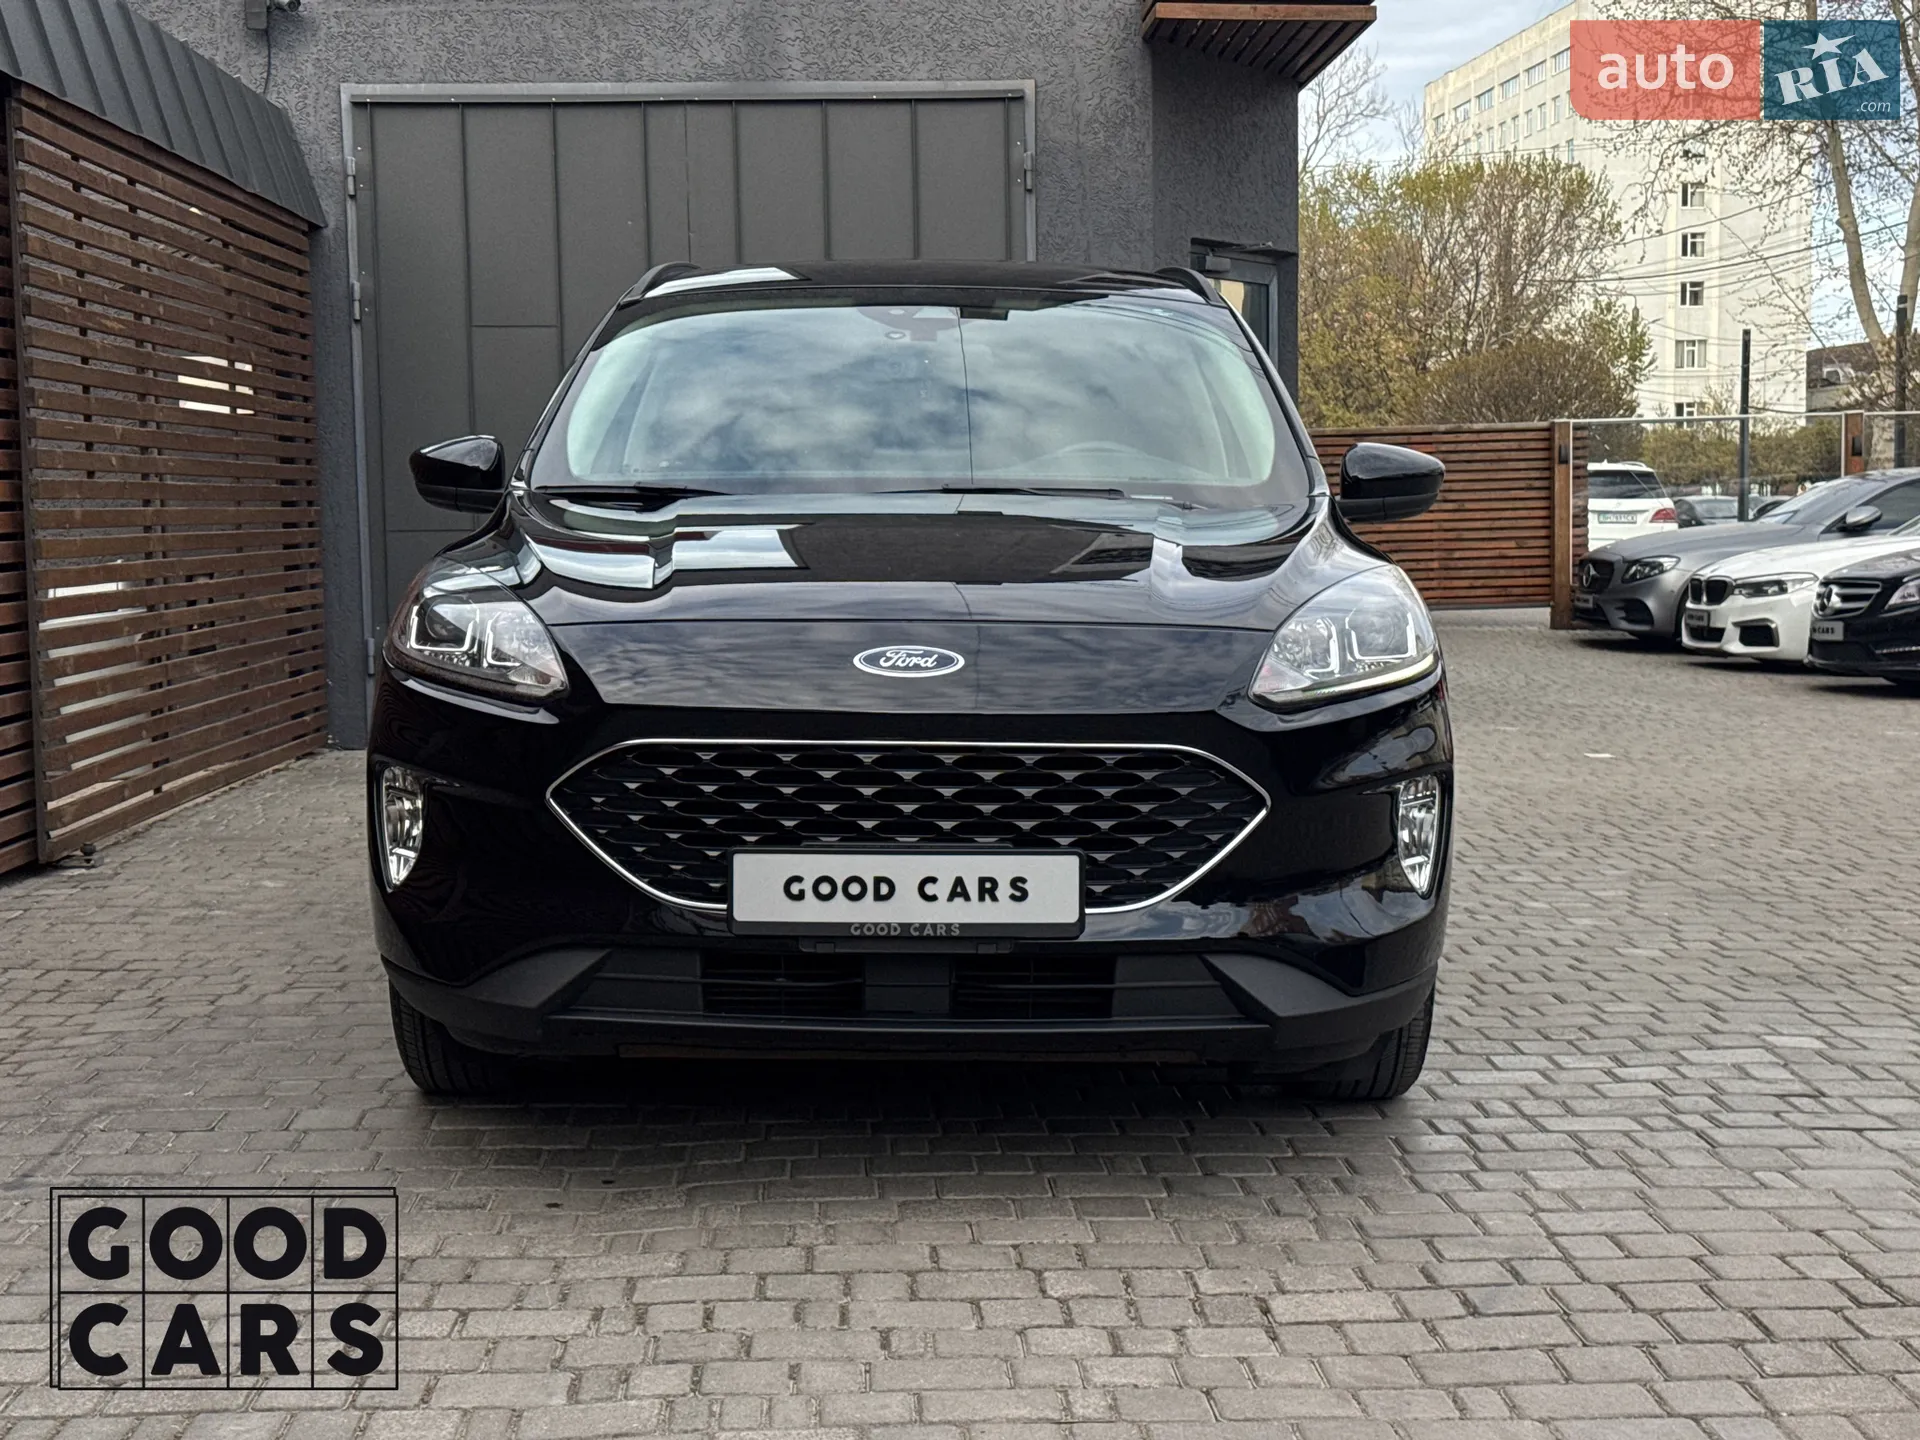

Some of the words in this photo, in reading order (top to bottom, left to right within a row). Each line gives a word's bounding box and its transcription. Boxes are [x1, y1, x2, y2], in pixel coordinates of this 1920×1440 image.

[879, 649, 938, 669] Ford
[783, 875, 896, 902] GOOD
[917, 876, 1030, 903] CARS
[850, 923, 900, 937] GOOD
[910, 923, 961, 937] CARS
